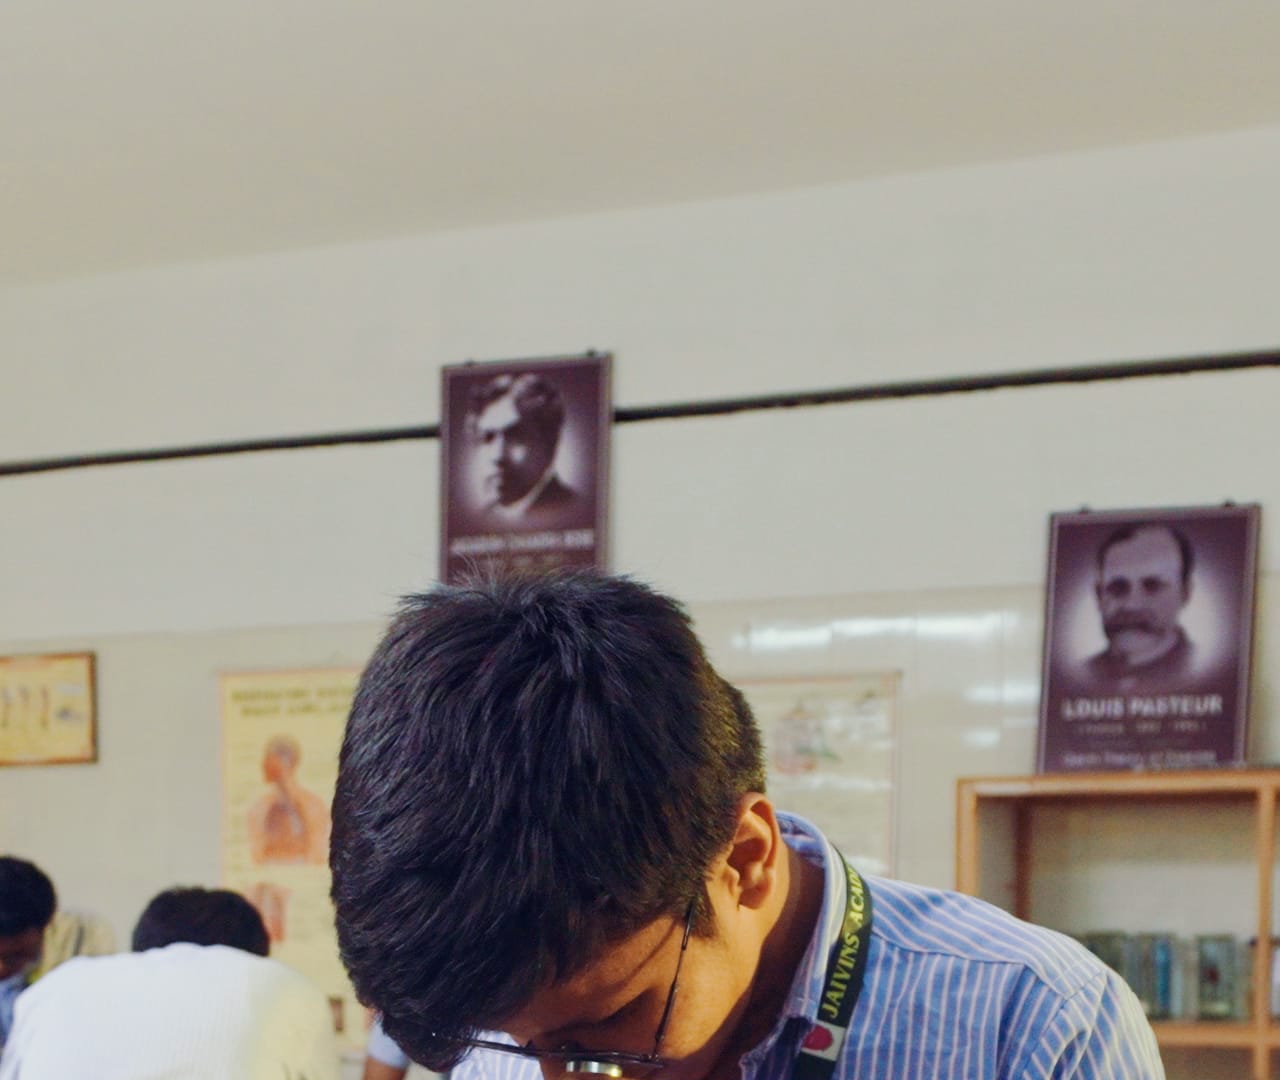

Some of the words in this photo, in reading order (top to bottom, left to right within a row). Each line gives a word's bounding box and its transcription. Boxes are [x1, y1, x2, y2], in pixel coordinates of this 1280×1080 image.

[1062, 697, 1124, 720] LOUIS
[1128, 694, 1223, 716] PASTEUR
[822, 933, 860, 1019] JAIVINS
